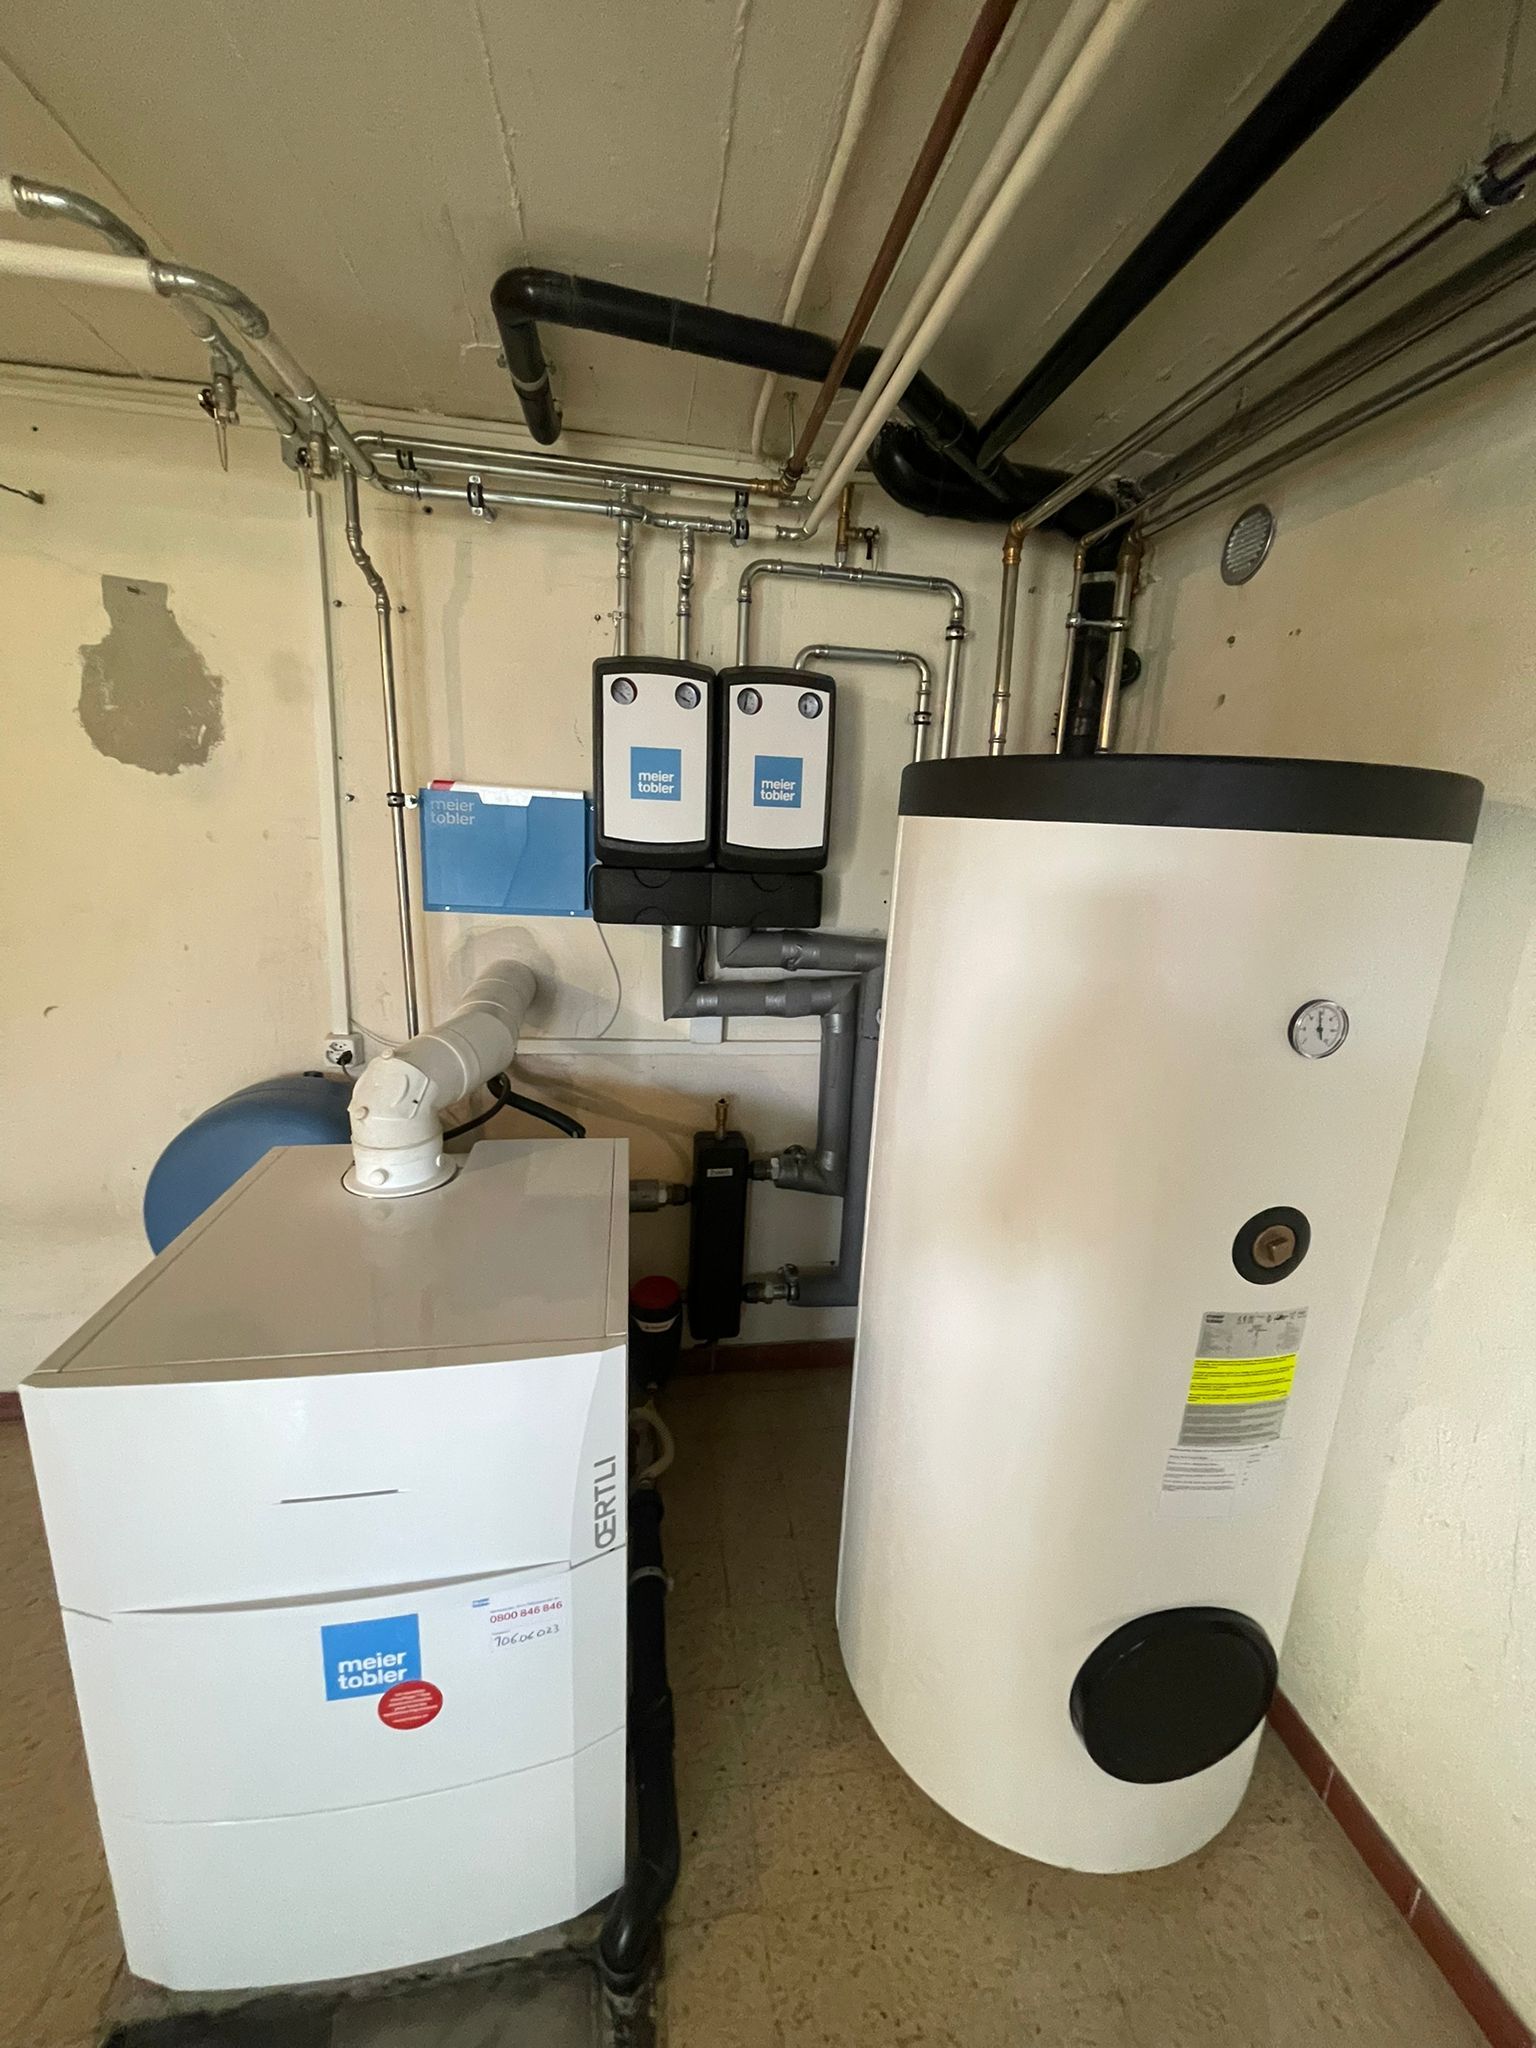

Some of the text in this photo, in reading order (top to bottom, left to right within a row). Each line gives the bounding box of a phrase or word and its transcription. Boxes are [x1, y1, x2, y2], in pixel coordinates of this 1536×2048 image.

[638, 770, 674, 782] meier
[637, 782, 674, 794] tobler
[761, 778, 796, 790] meier
[760, 789, 795, 801] tobler
[430, 799, 475, 811] meier
[431, 812, 475, 825] tobler
[490, 1611, 518, 1623] 0800
[520, 1605, 541, 1617] 846
[542, 1600, 563, 1612] 846
[338, 1651, 407, 1674] meier
[338, 1667, 408, 1690] tobler
